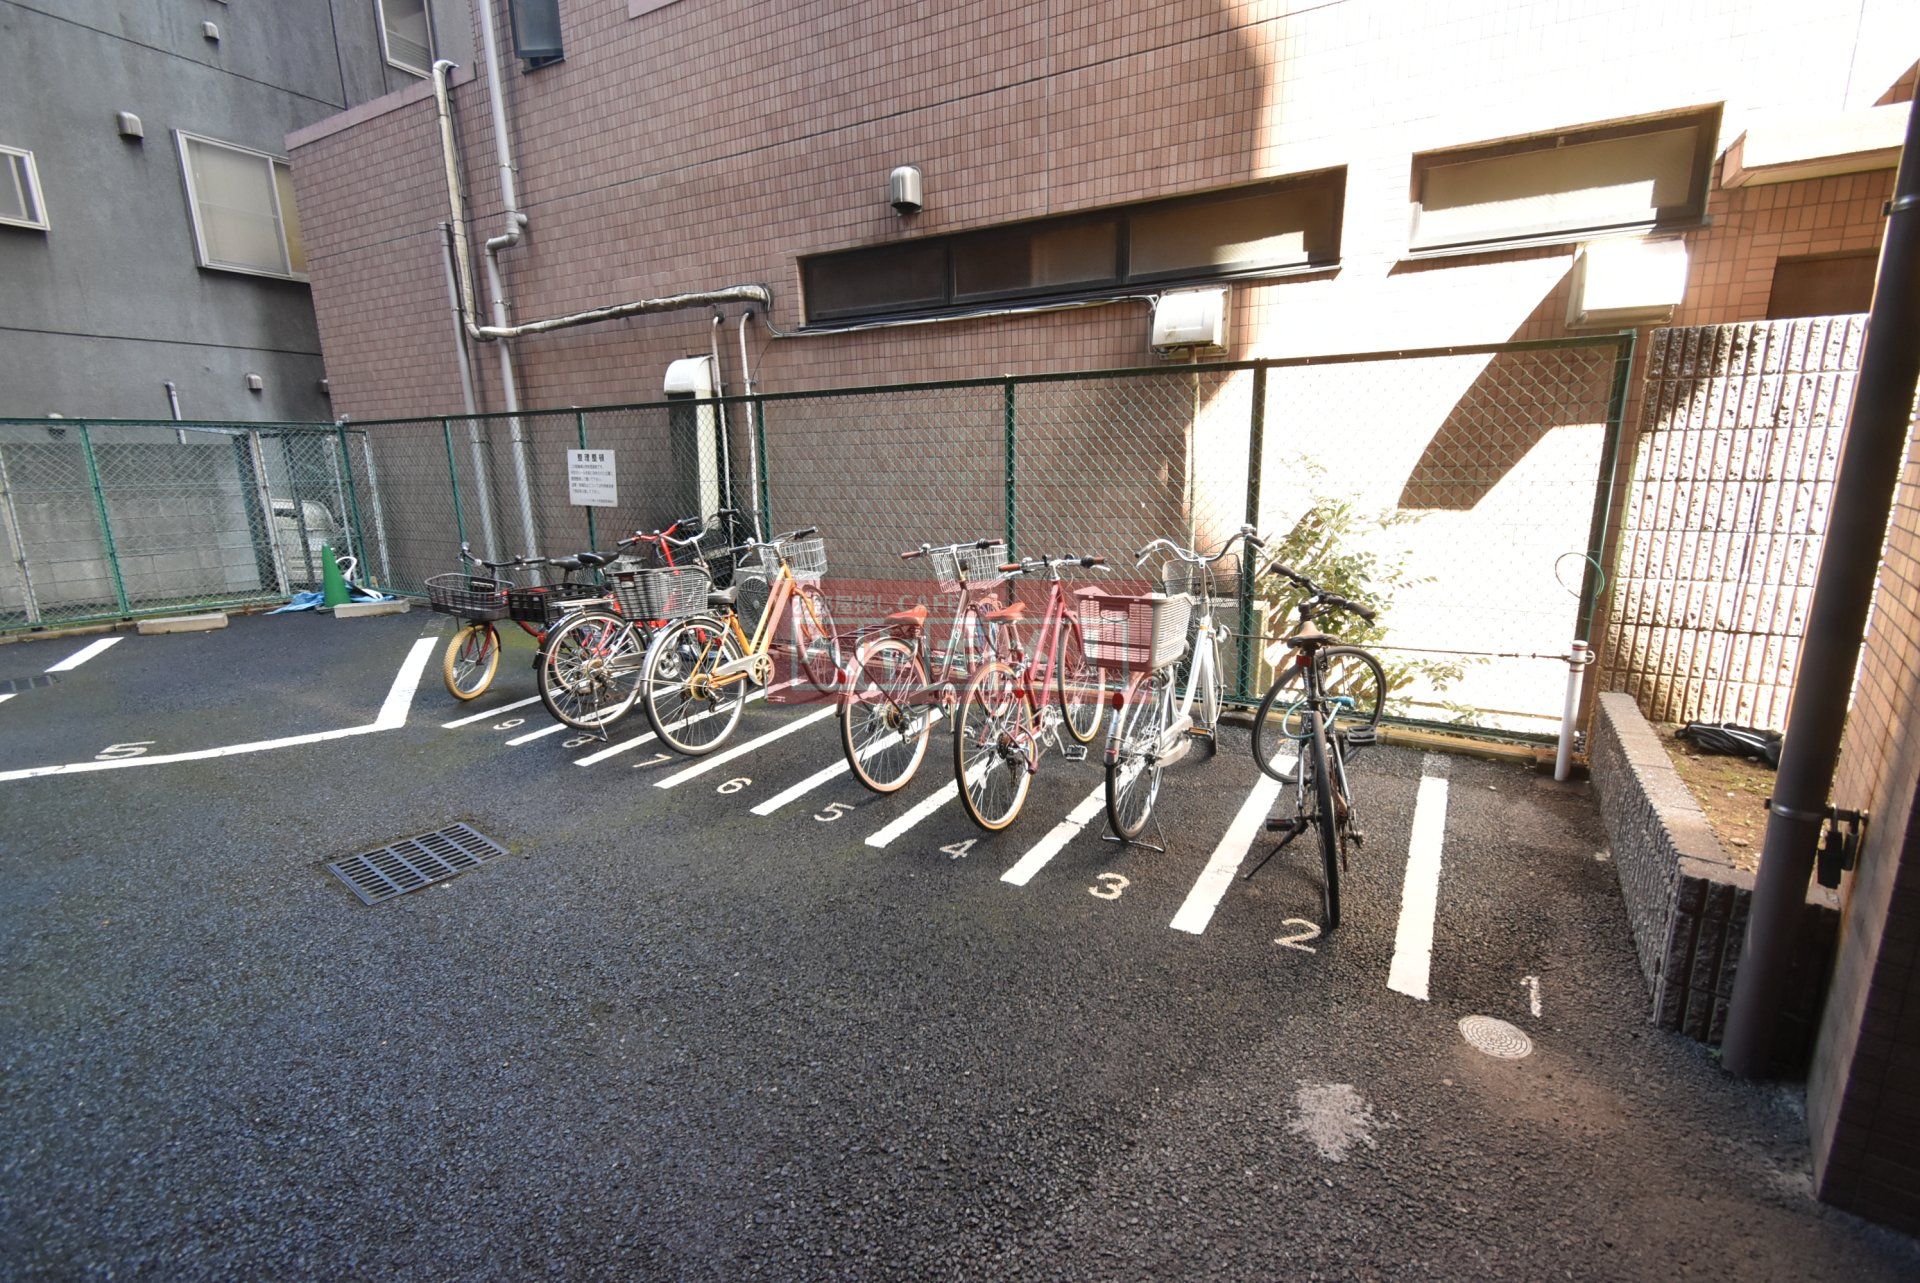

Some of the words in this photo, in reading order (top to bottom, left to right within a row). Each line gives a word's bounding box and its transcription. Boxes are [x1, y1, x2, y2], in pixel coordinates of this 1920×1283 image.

[493, 718, 525, 730] 9
[94, 741, 156, 760] 5
[716, 777, 752, 794] 6
[813, 802, 855, 821] 5
[939, 838, 978, 859] 4
[1088, 872, 1130, 900] 3
[1274, 918, 1321, 953] 2
[1520, 975, 1542, 1018] 1
